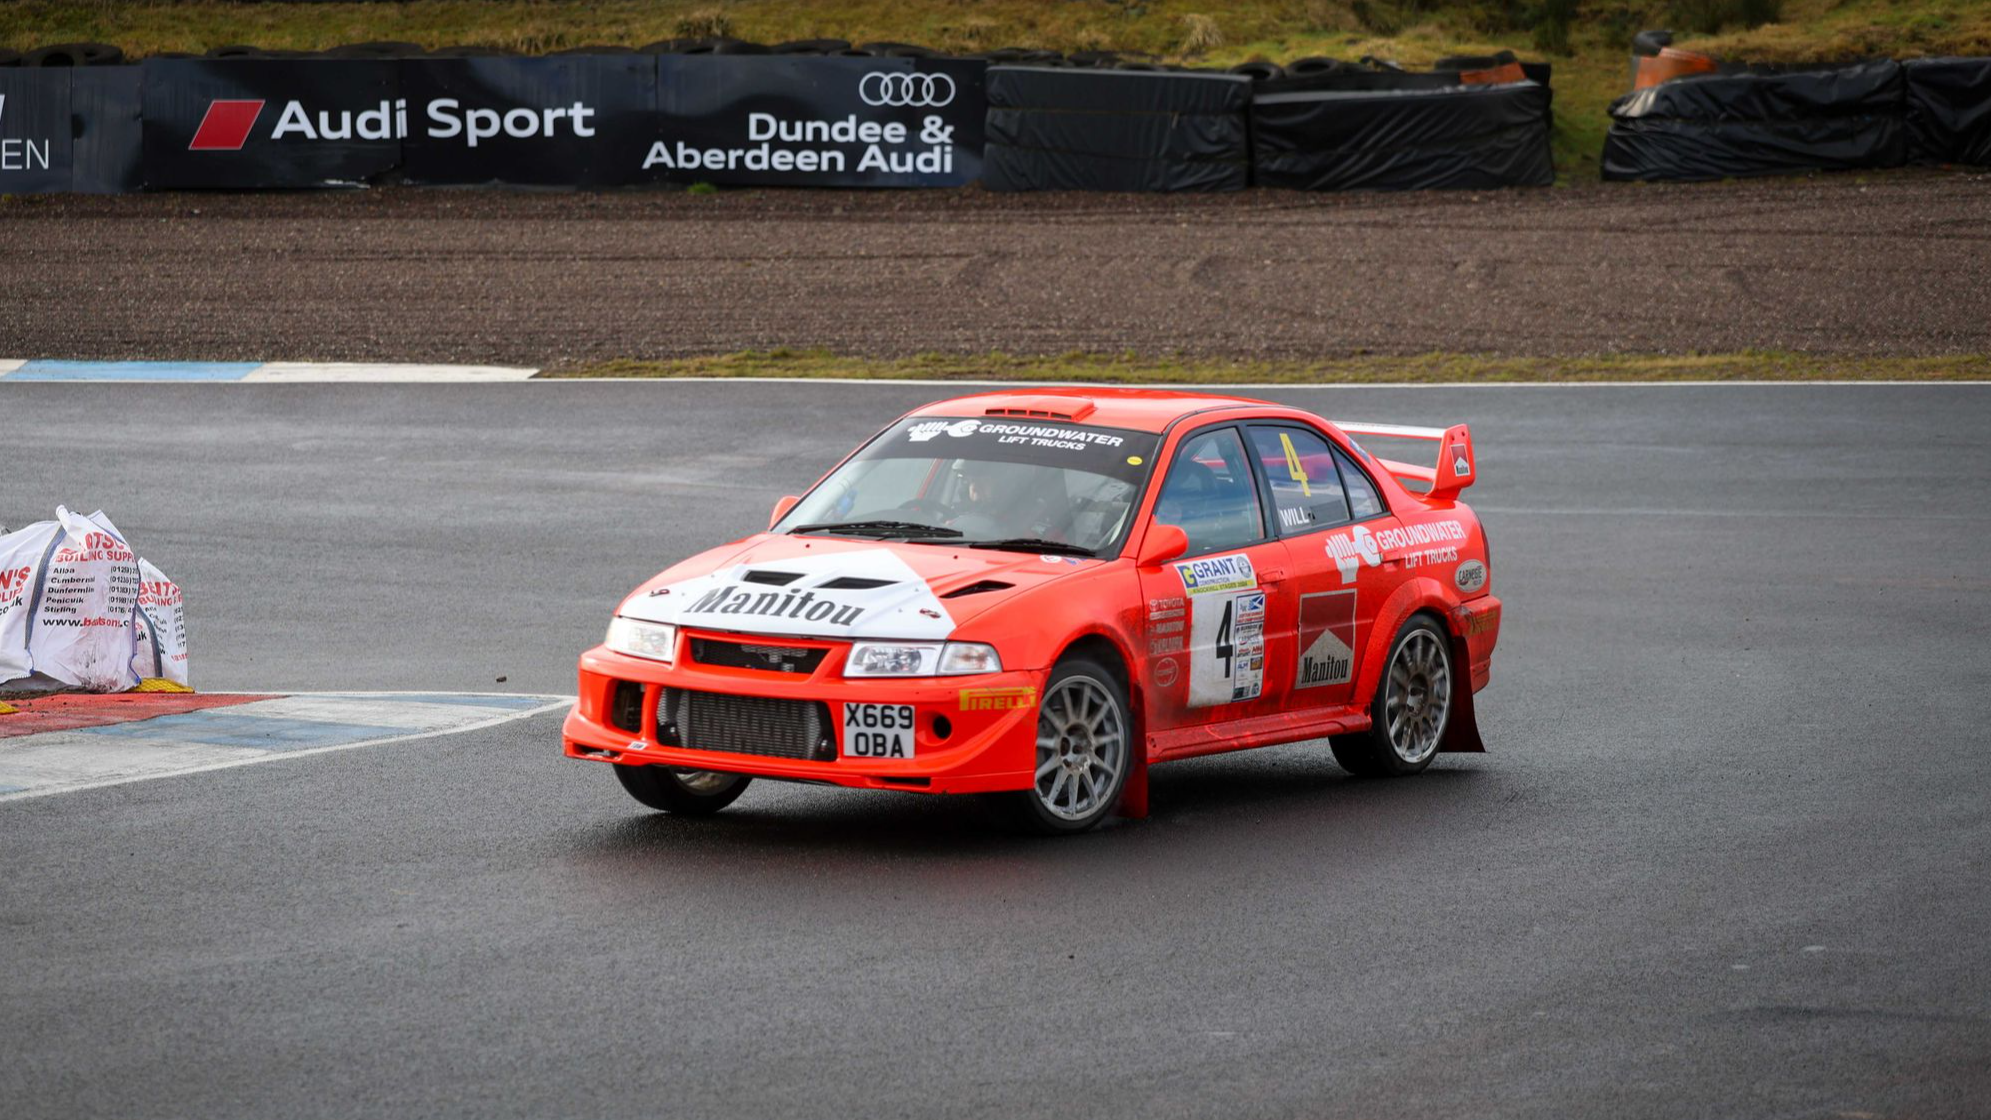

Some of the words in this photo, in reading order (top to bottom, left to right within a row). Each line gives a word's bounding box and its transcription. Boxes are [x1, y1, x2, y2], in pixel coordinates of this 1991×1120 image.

[272, 99, 408, 140] Audi
[427, 99, 596, 147] Sport
[749, 113, 906, 143] Dundee
[920, 115, 955, 143] &
[642, 141, 845, 172] Aberdeen
[856, 145, 952, 173] Audi
[979, 424, 1124, 447] GROUNDWATER
[998, 435, 1030, 446] LIFT
[1031, 437, 1086, 450] TRUCKS
[1279, 433, 1311, 497] 4
[1376, 520, 1466, 550] GROUNDWATER
[1192, 558, 1237, 578] GRANT
[1404, 551, 1423, 569] LIFT
[1424, 546, 1458, 564] TRUCKS
[683, 585, 867, 627] Manitou
[1216, 600, 1233, 679] 4
[1301, 654, 1348, 684] Manitou
[959, 687, 1037, 711] PIRELLI
[845, 704, 914, 729] X669
